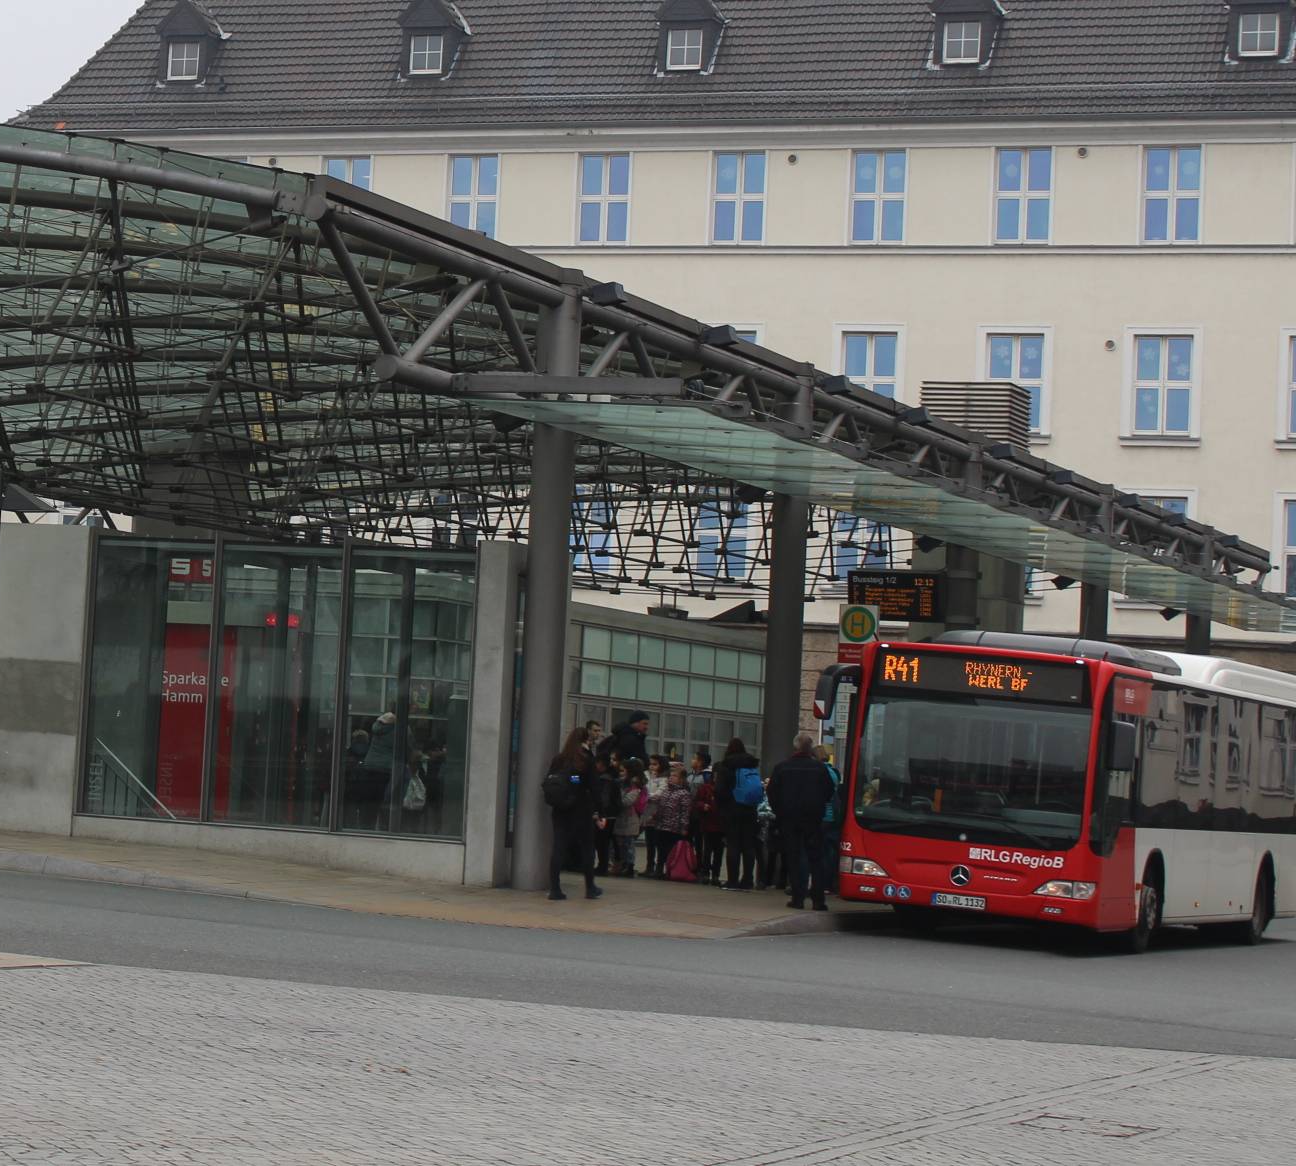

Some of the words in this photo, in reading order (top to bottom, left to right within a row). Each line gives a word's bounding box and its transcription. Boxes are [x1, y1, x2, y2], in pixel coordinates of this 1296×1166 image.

[852, 575, 884, 585] Bussteig
[886, 576, 897, 584] 1/2
[914, 578, 934, 587] 12:12
[884, 655, 919, 682] R41
[965, 661, 1022, 679] RHYNERN
[163, 670, 229, 687] Sparkae
[969, 675, 1004, 689] WERL
[1011, 678, 1029, 691] BF
[162, 689, 203, 704] Hamm
[88, 758, 104, 800] INSEL
[981, 849, 1010, 863] RLG
[1011, 852, 1064, 869] RegioB
[936, 894, 947, 904] SO
[953, 896, 962, 906] RL
